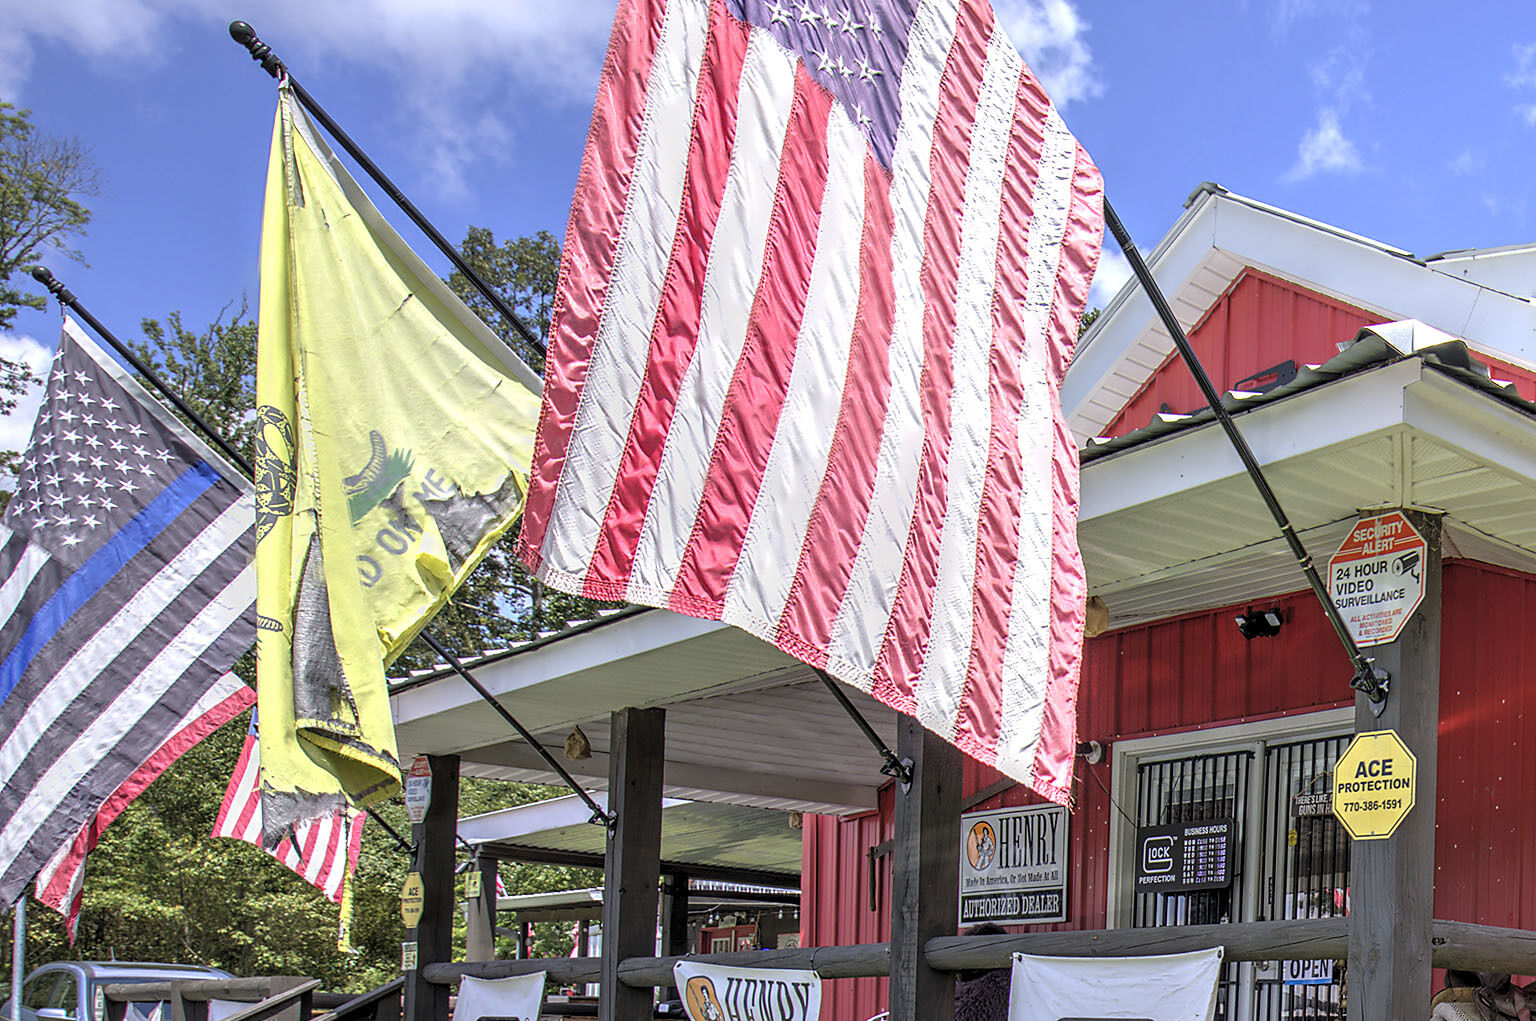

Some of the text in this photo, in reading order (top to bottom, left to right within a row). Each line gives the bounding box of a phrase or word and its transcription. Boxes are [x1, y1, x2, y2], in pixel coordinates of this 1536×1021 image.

[1353, 520, 1404, 542] SECURITY
[1362, 537, 1395, 555] ALERT
[1336, 560, 1388, 580] 24 HOUR
[1336, 579, 1374, 595] VIDEO
[1335, 588, 1406, 609] SURVEILLANCE
[1360, 617, 1393, 628] MONITORED
[1364, 625, 1393, 636] RECORDED
[1355, 759, 1393, 778] ACE
[1338, 777, 1410, 793] PROTECTION
[1316, 794, 1329, 803] LIKE
[1344, 798, 1402, 812] 770-386-1591
[1299, 803, 1316, 816] GUNS
[1184, 824, 1228, 836] BUSINESS HOURS
[998, 812, 1060, 869] HENRY
[1028, 872, 1043, 882] Made
[1044, 872, 1050, 881] At
[1138, 874, 1176, 884] PERFECTION
[408, 887, 419, 896] ACE
[963, 894, 1060, 918] AUTHORIZED DEALER
[1290, 959, 1329, 978] OPEN
